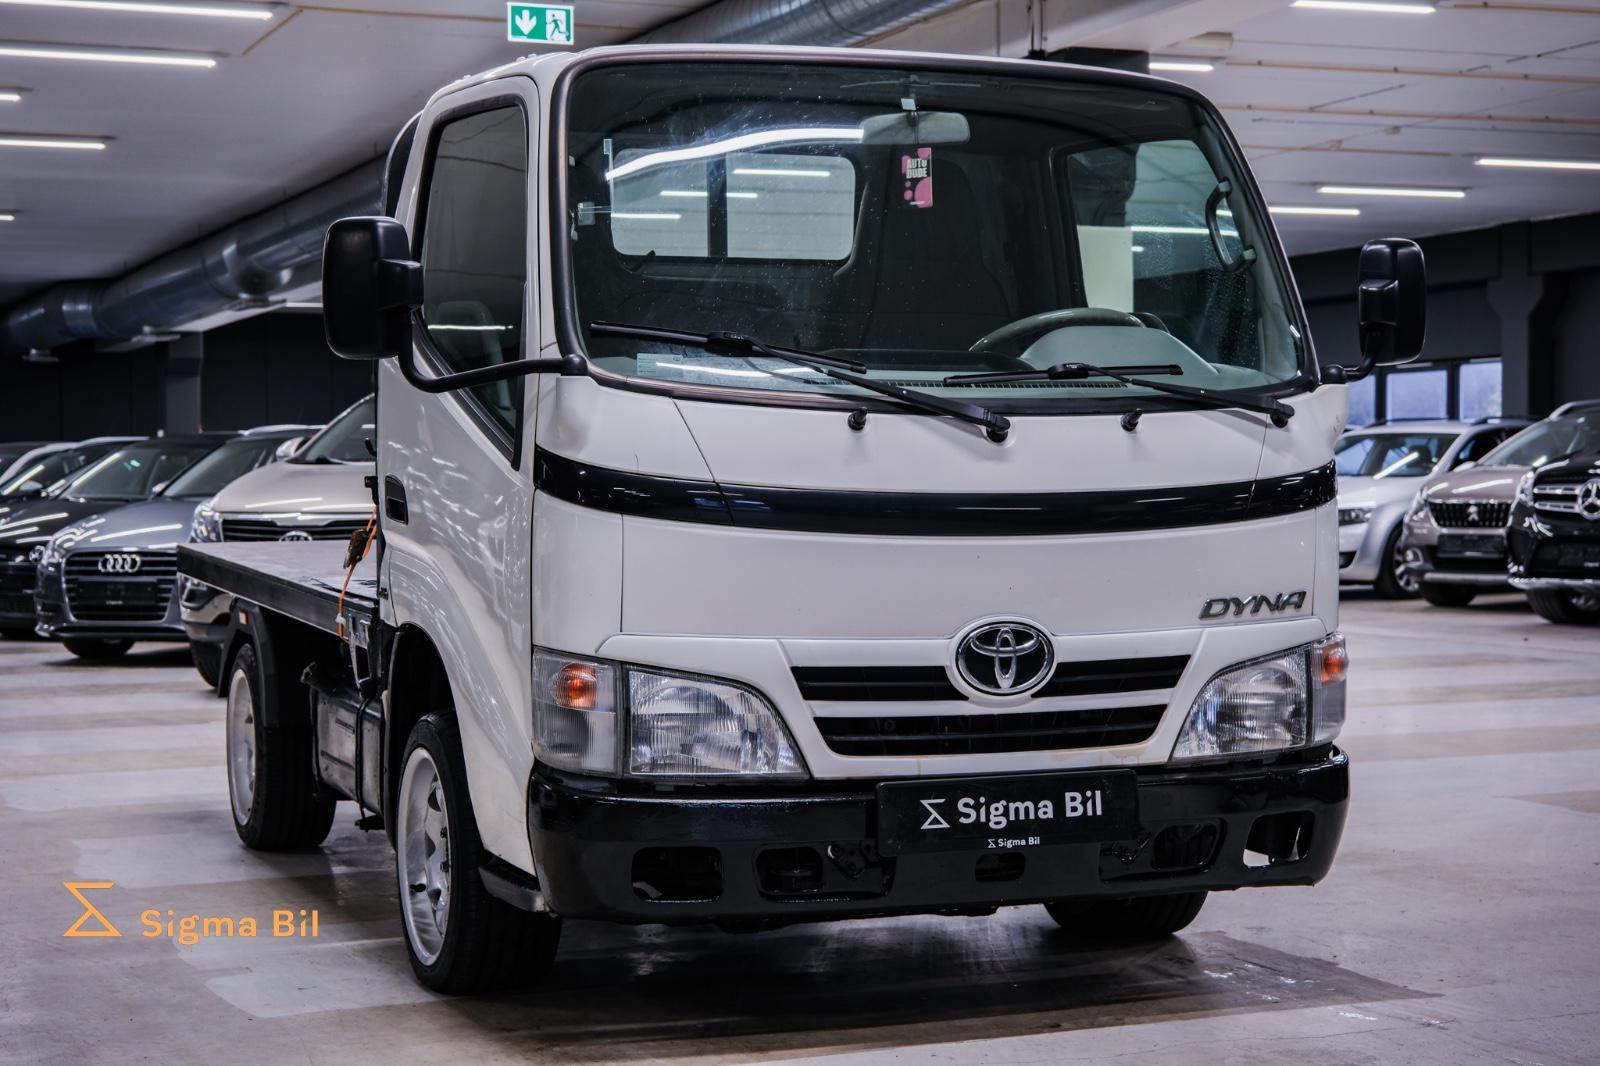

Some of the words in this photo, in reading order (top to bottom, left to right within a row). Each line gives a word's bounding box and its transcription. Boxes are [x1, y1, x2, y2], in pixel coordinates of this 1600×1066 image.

[906, 158, 927, 169] AUTO
[906, 167, 927, 179] DUDE
[1198, 590, 1306, 620] DYNA
[957, 796, 1053, 829] Sigma
[1064, 790, 1102, 818] Bil
[997, 838, 1026, 849] Sigma
[1028, 836, 1040, 845] Bil
